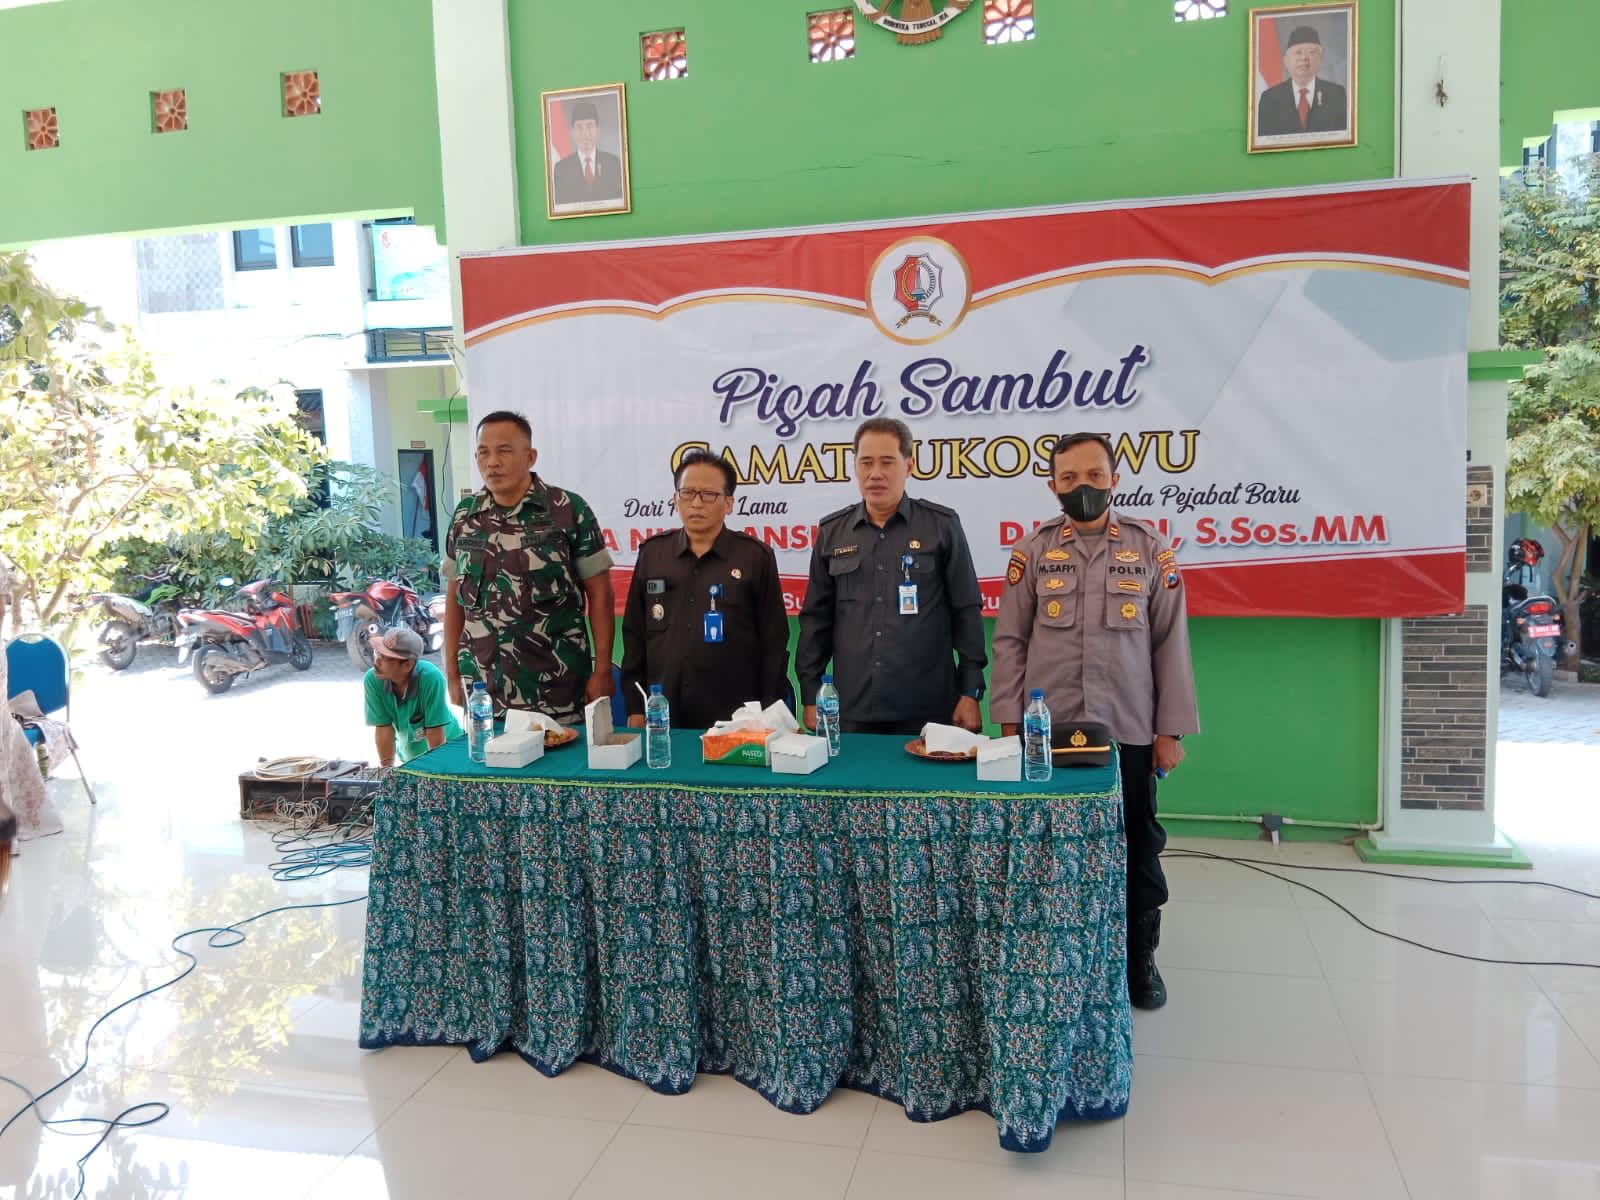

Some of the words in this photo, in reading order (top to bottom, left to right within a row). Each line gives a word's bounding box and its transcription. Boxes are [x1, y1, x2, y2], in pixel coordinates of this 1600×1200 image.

[900, 345, 1146, 416] Sambut
[911, 430, 1201, 480] UKOSWU
[624, 498, 665, 517] Dari
[737, 496, 789, 516] Lama
[1160, 482, 1244, 514] Pejabat
[1245, 482, 1301, 505] Baru
[1195, 514, 1387, 545] S.Sos.MM
[1109, 566, 1147, 575] POLRI
